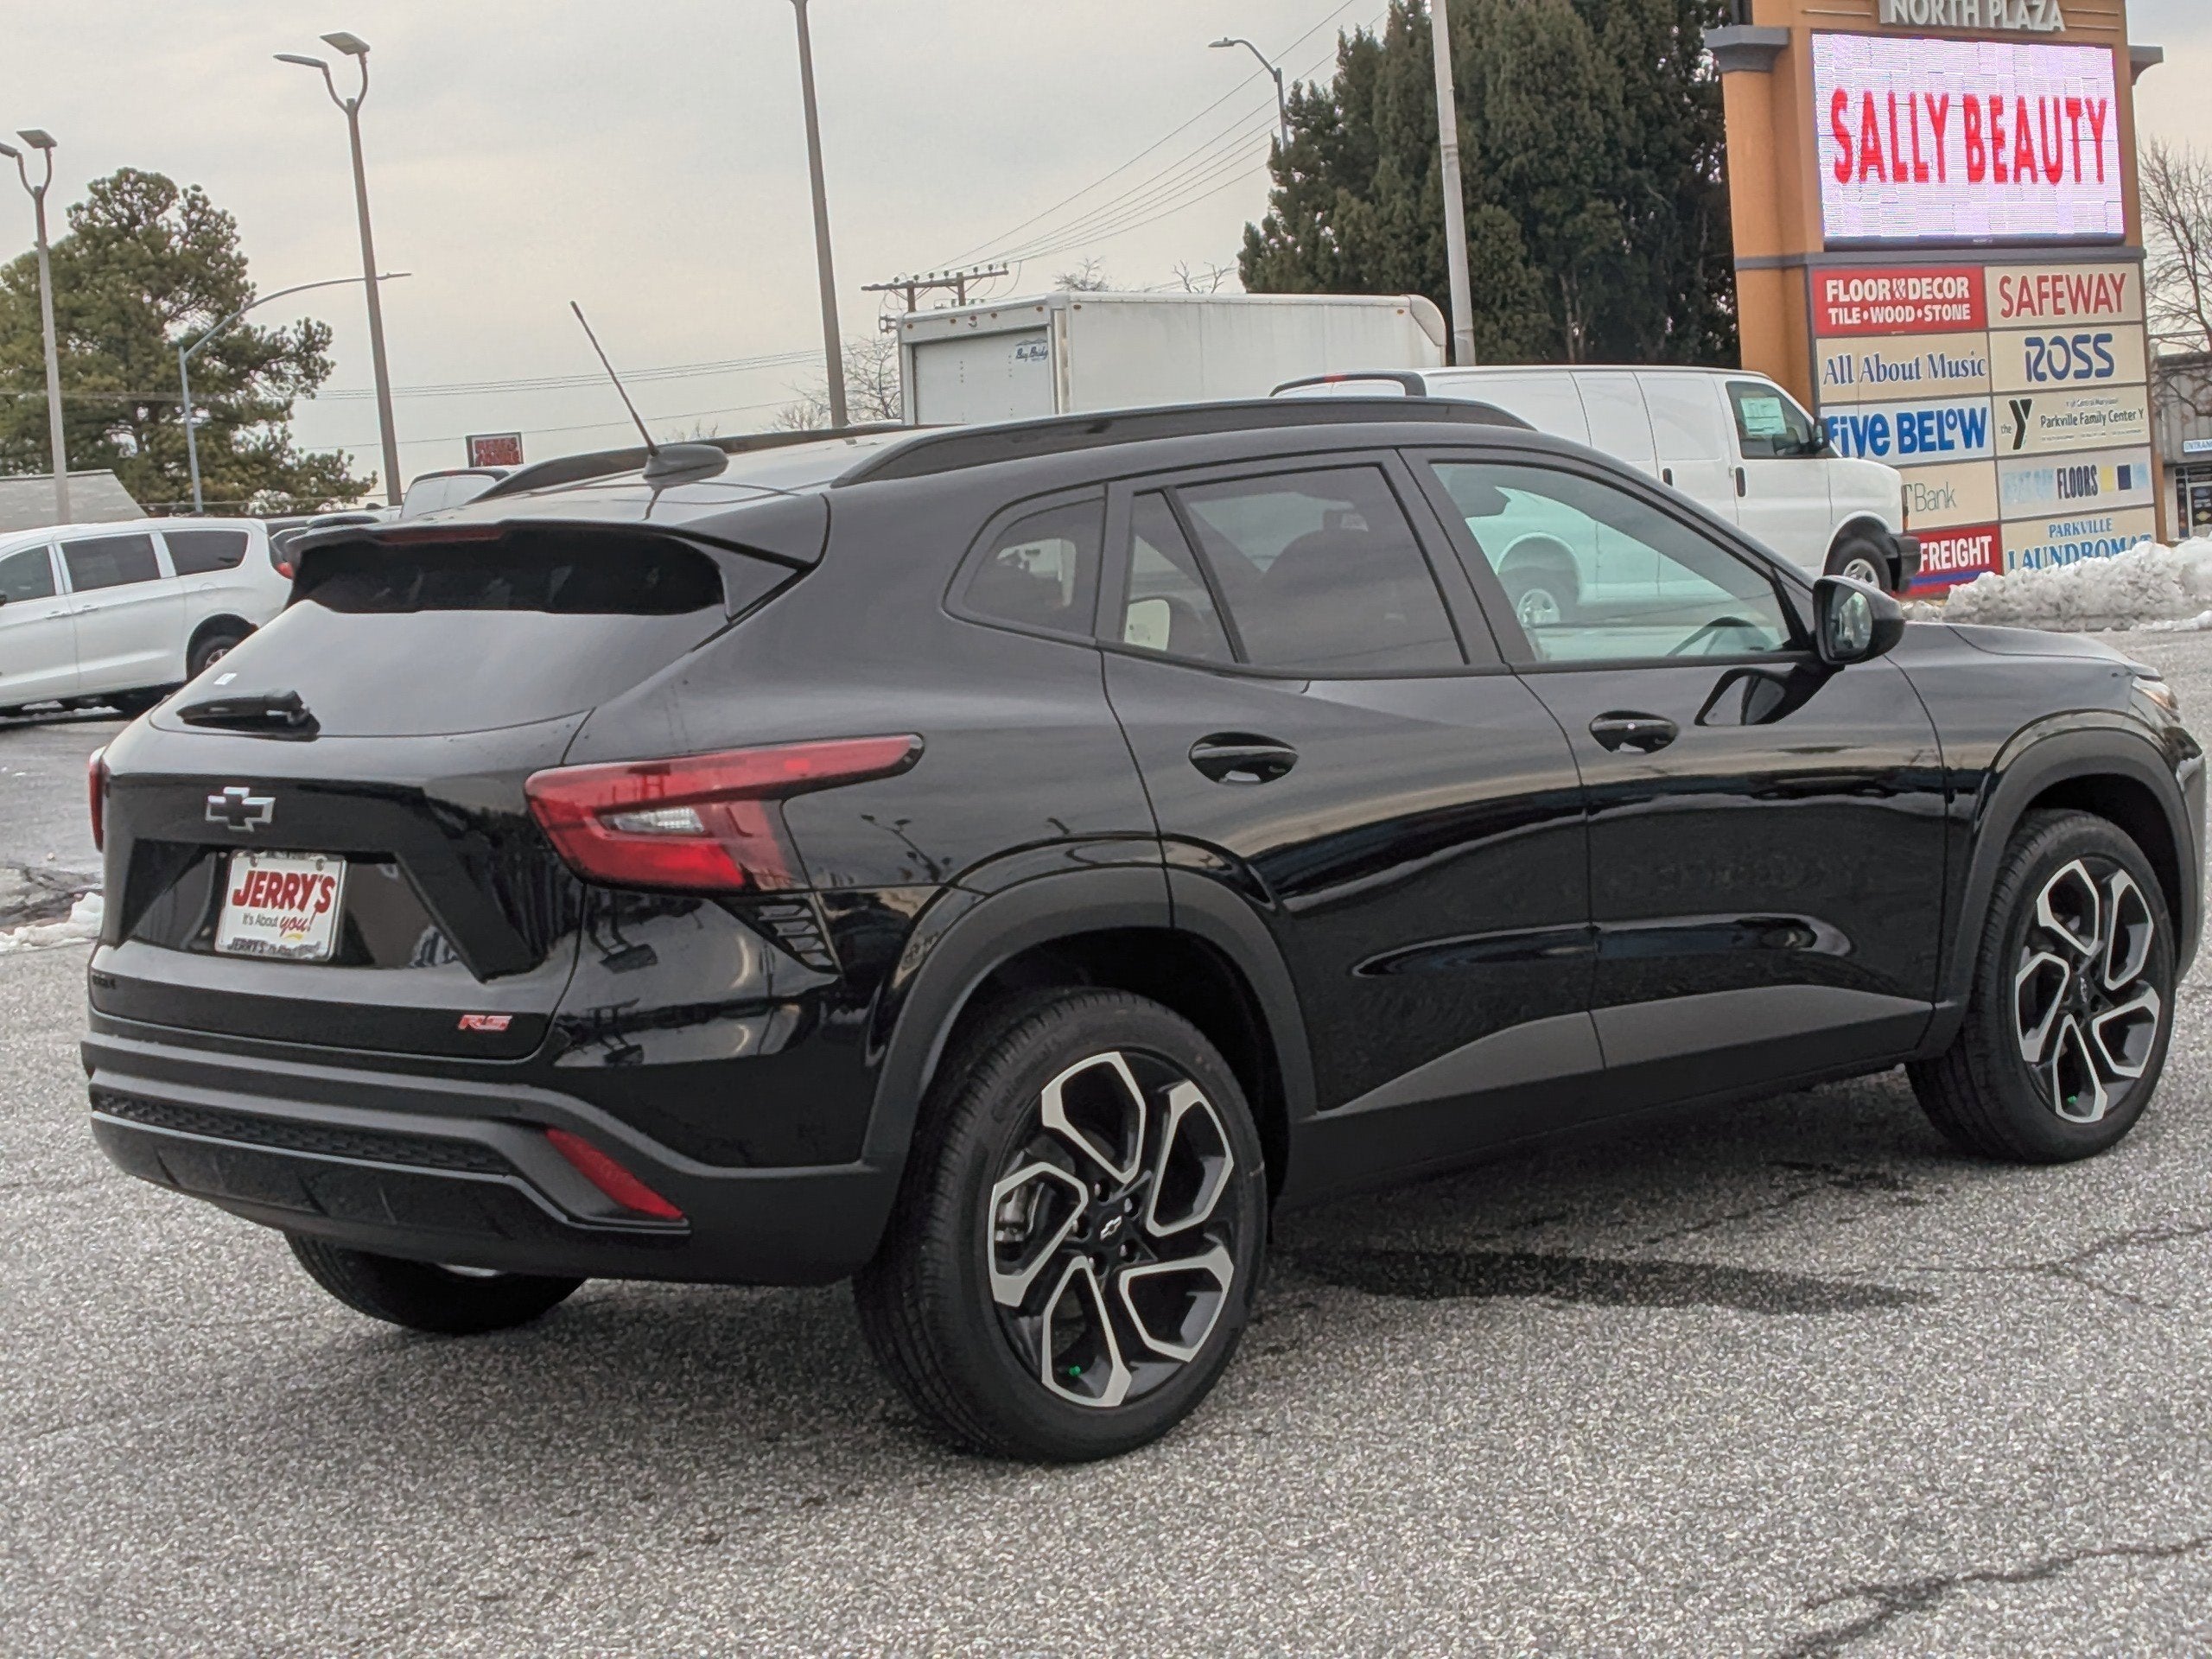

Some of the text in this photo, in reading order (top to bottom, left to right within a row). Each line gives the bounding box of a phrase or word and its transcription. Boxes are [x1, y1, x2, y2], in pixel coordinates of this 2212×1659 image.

[1890, 0, 2066, 32] NORTH PLAZA
[1830, 87, 2107, 185] SALLY BEAUTY
[1826, 278, 1891, 302] FLOOR
[1908, 276, 1970, 300] DECOR
[1999, 272, 2126, 318] SAFEWAY
[1828, 303, 1971, 325] TILE WOOD STONE
[1823, 350, 1986, 385] All About Music
[2024, 334, 2115, 383] ROSS
[2040, 409, 2145, 428] Parkville Family Center Y
[1914, 481, 1957, 512] Bank
[2056, 464, 2098, 499] FLOORS
[2049, 518, 2113, 537] PARKVILLE
[1920, 535, 1993, 571] FREIGHT
[232, 869, 336, 913] JERRY'S
[457, 1014, 513, 1032] RS
